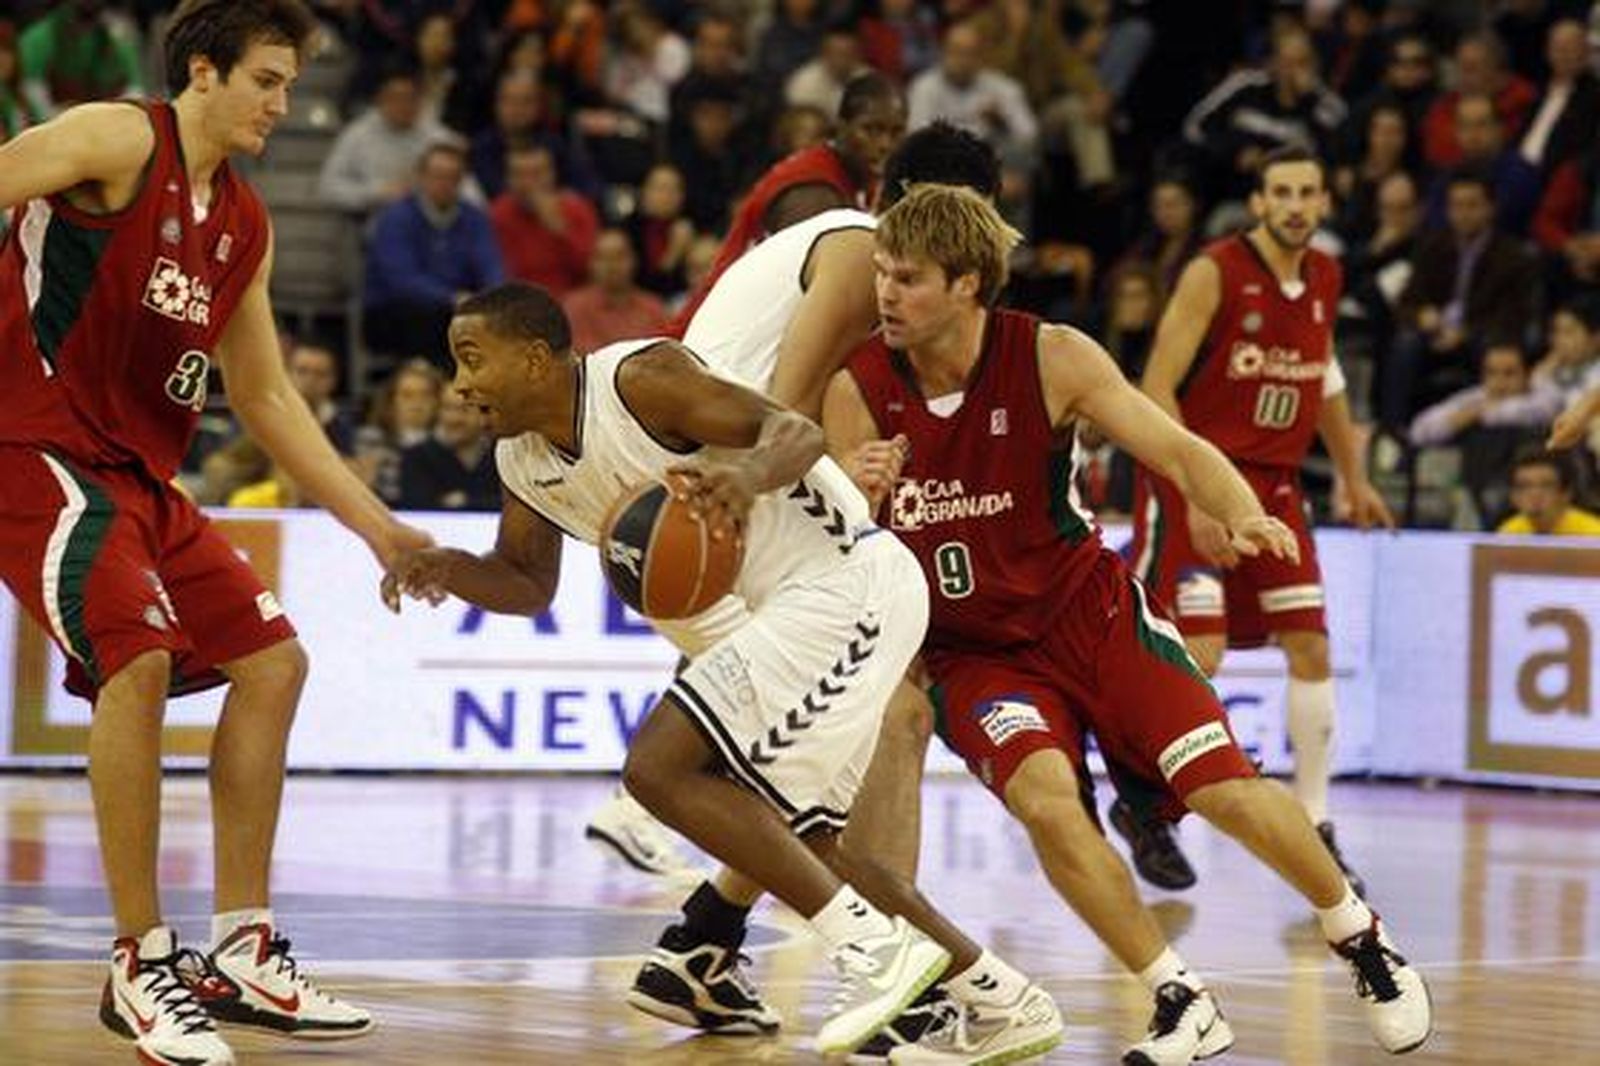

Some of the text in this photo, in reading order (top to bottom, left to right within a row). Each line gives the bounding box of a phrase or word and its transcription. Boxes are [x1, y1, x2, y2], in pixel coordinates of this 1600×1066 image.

[924, 491, 1013, 524] GRANADA
[934, 541, 975, 599] 9
[1516, 606, 1591, 718] a
